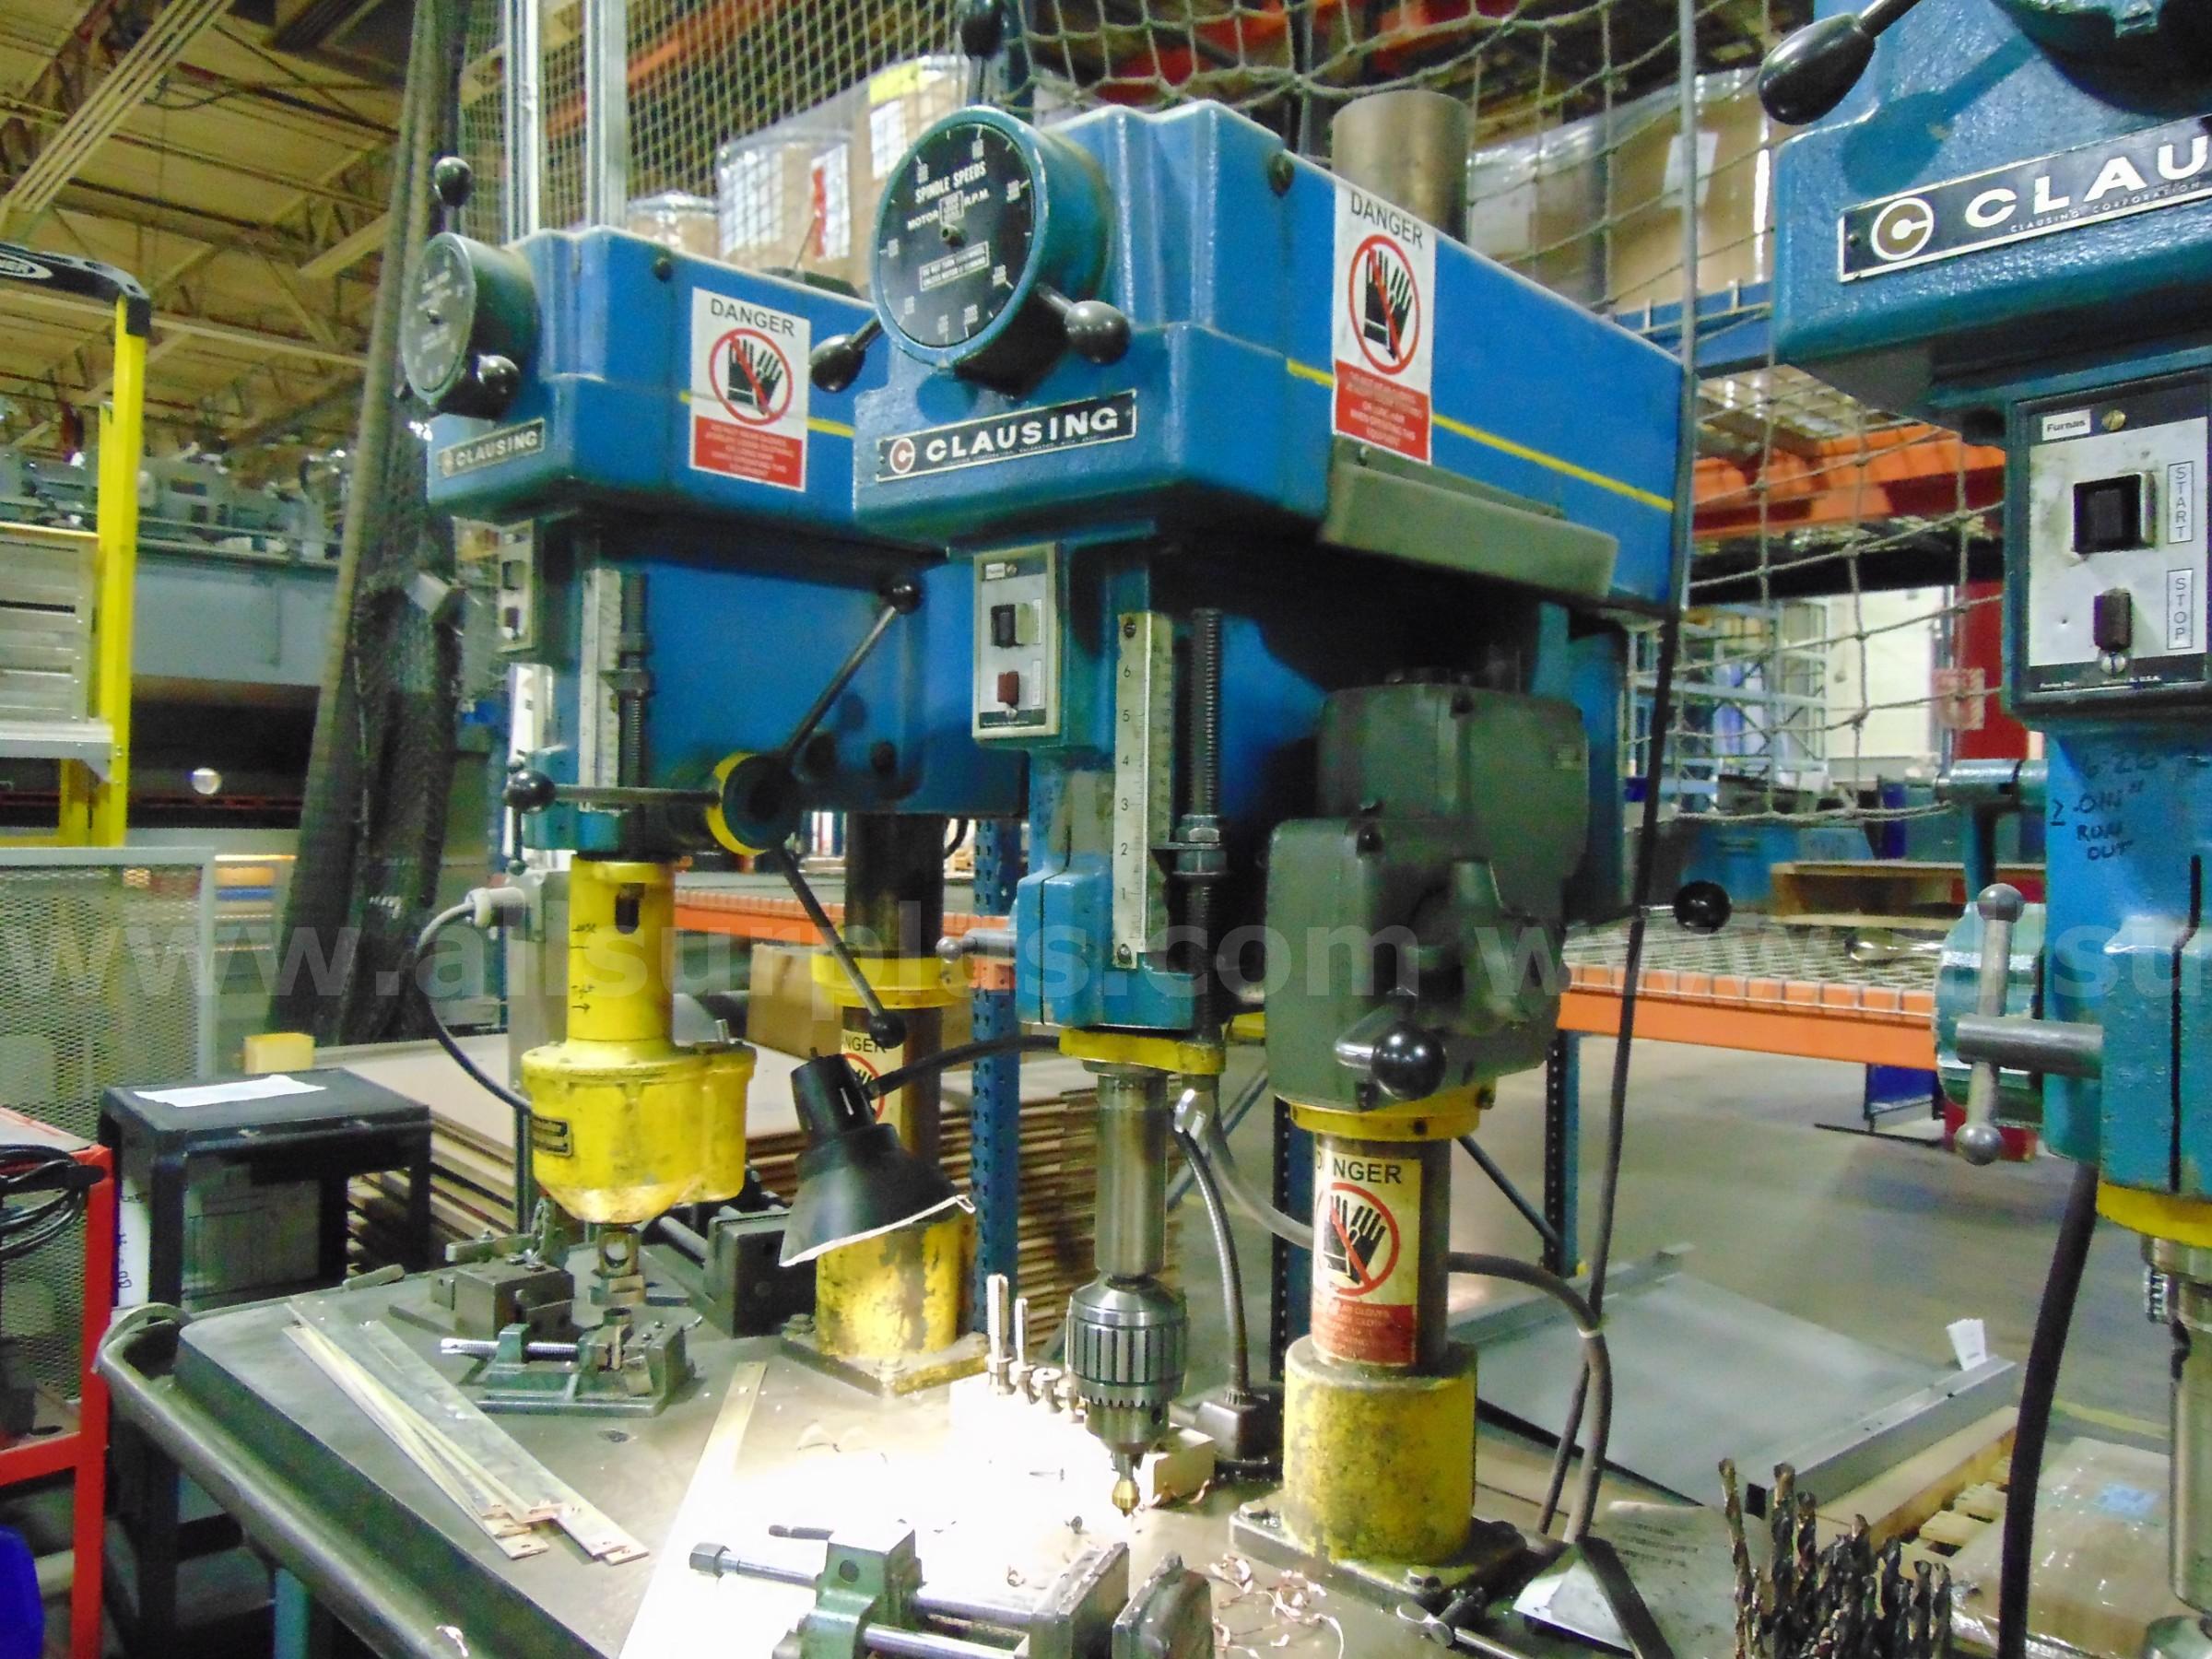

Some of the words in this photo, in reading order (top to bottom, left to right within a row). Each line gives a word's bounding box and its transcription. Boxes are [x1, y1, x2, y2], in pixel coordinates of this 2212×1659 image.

[1350, 190, 1423, 249] DANGER
[2010, 210, 2080, 233] CLAUSING
[710, 298, 796, 337] DANGER
[455, 429, 538, 466] CLAUSING
[926, 407, 1118, 462] CLAUSING
[2046, 419, 2087, 433] Furnas
[2175, 466, 2187, 540] START
[2173, 577, 2186, 639] STOP
